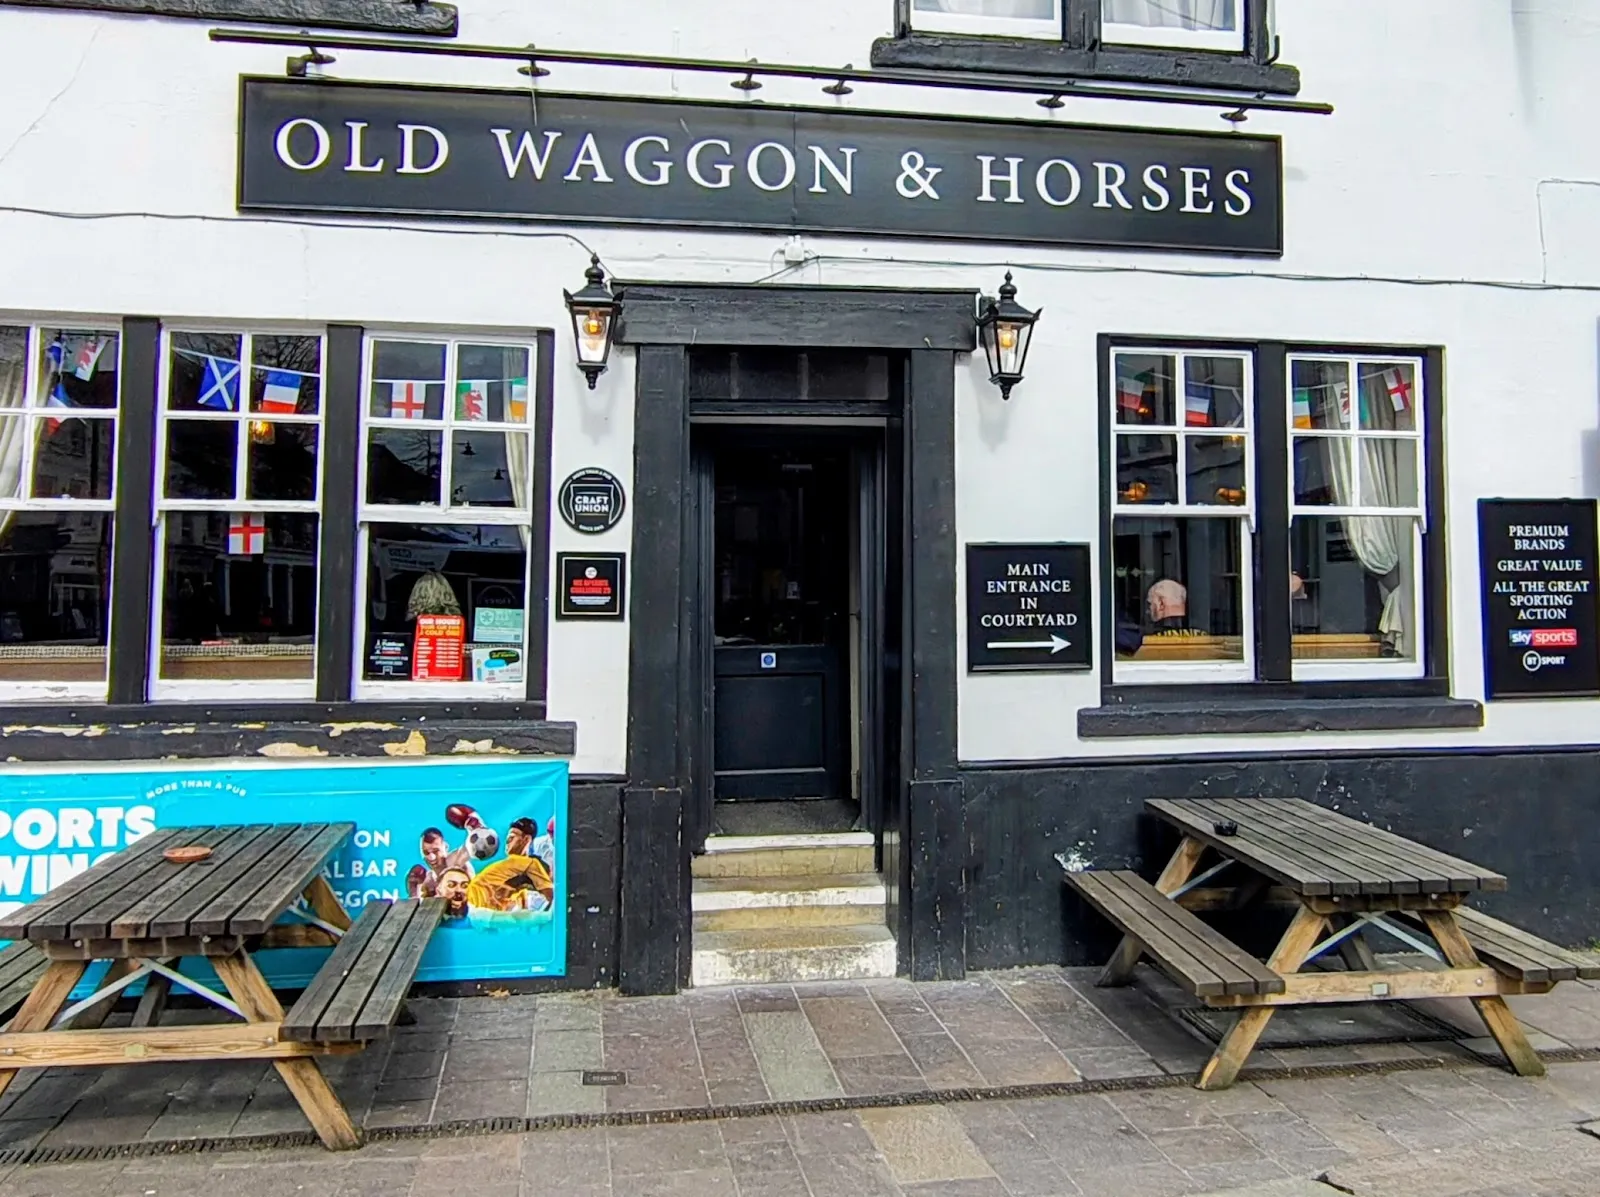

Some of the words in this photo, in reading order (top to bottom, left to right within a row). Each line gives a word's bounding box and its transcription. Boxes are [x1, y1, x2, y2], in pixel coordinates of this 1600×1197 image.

[276, 118, 449, 174] OLD
[490, 128, 857, 195] WAGGON
[895, 150, 943, 200] &
[976, 155, 1252, 216] HORSES
[574, 496, 609, 504] CRAFT
[1508, 525, 1569, 537] PREMIUM
[1514, 539, 1565, 550] BRANDS
[1007, 564, 1050, 576] MAIN
[1497, 560, 1540, 571] GREAT
[1542, 560, 1583, 571] VALUE
[987, 580, 1072, 593] ENTRANCE
[1493, 582, 1517, 593] ALL
[1519, 581, 1546, 593] THE
[1548, 581, 1590, 592] GREAT
[1020, 597, 1038, 610] IN
[1509, 594, 1573, 607] SPORTING
[981, 613, 1078, 627] COURTYARD
[1517, 608, 1567, 620] ACTION
[1511, 630, 1532, 645] sky
[1535, 631, 1575, 644] sports
[1526, 656, 1538, 666] BT
[1541, 656, 1566, 666] SPORT
[146, 782, 178, 799] MORE
[181, 780, 212, 788] THAN
[215, 781, 223, 789] A
[226, 783, 247, 797] PUB
[353, 830, 390, 848] ON
[351, 859, 398, 878] BAR
